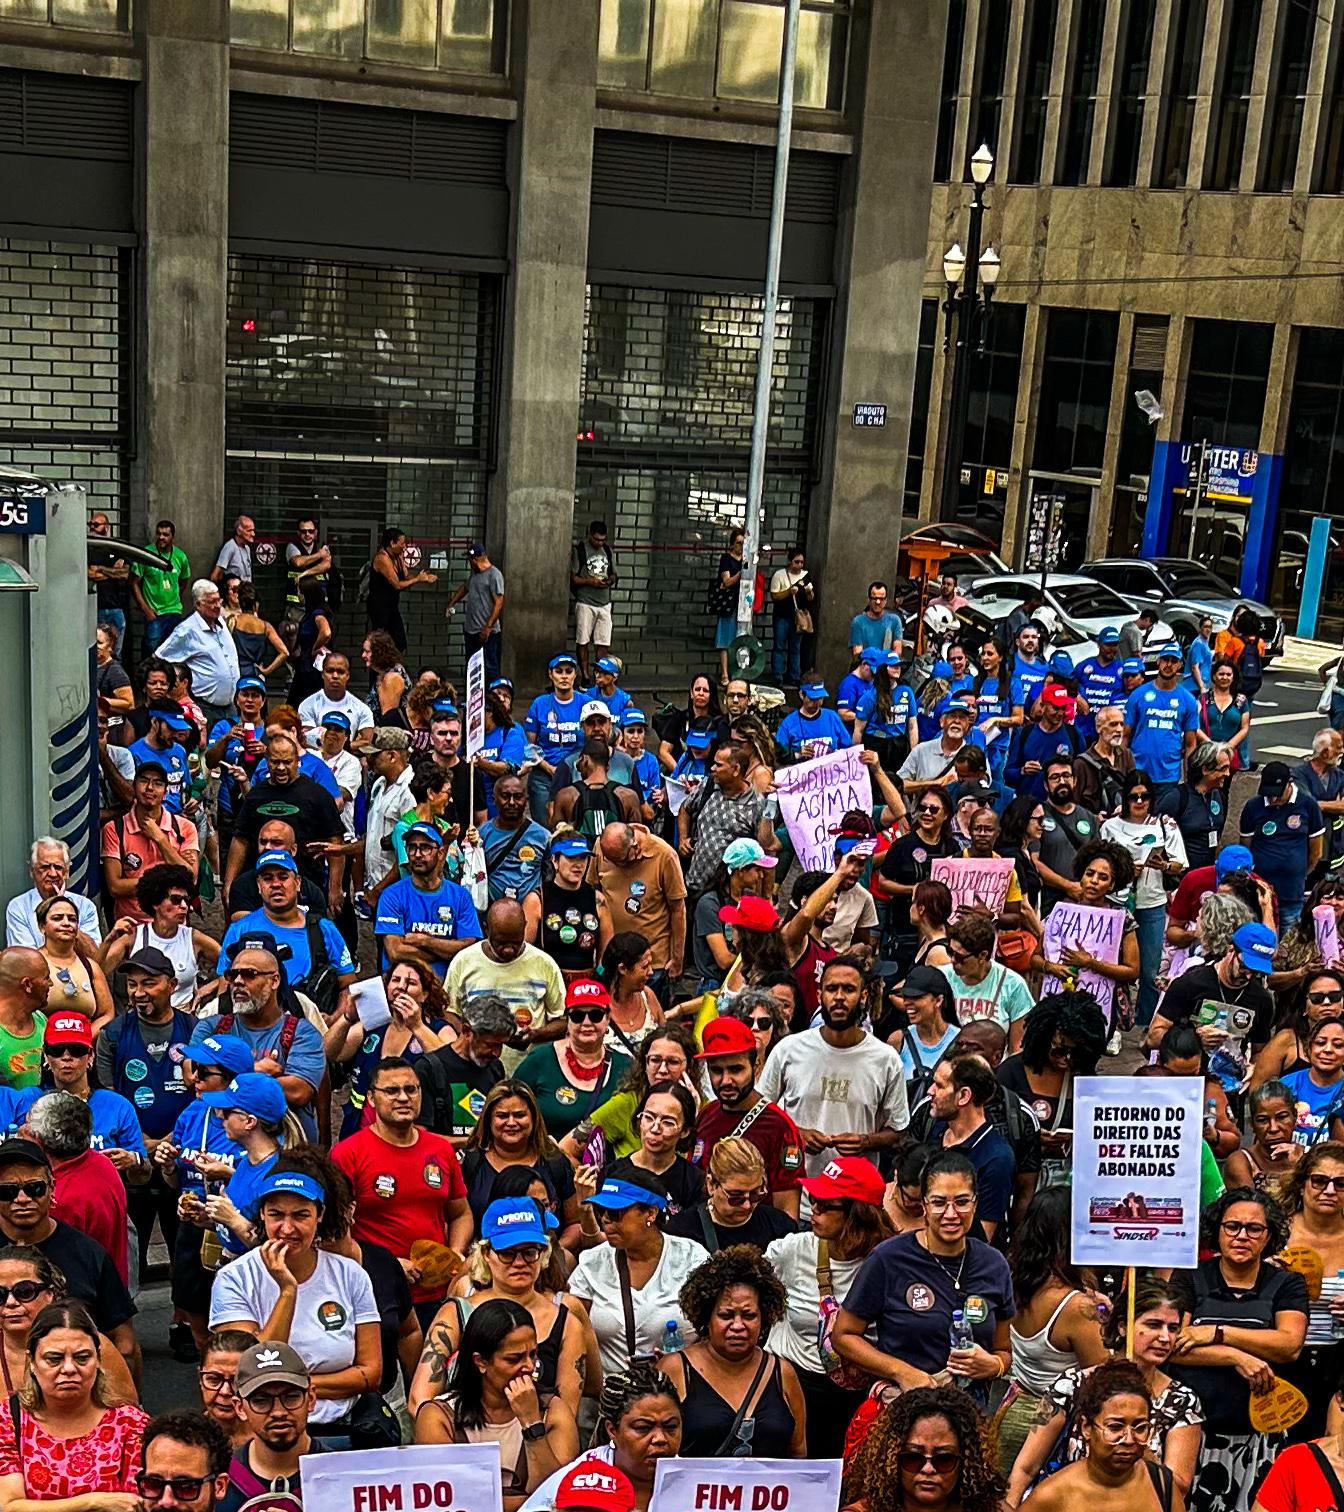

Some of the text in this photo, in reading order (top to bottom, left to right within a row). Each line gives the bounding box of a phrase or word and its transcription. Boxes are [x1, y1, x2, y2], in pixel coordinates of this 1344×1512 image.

[1094, 1107, 1185, 1122] RETORNO DO
[1093, 1125, 1181, 1140] DIREITO DAS
[1098, 1144, 1180, 1158] DEZ FALTAS
[1097, 1162, 1175, 1177] ABONADAS
[353, 1481, 453, 1512] FIM DO
[695, 1483, 789, 1511] FIM DO
